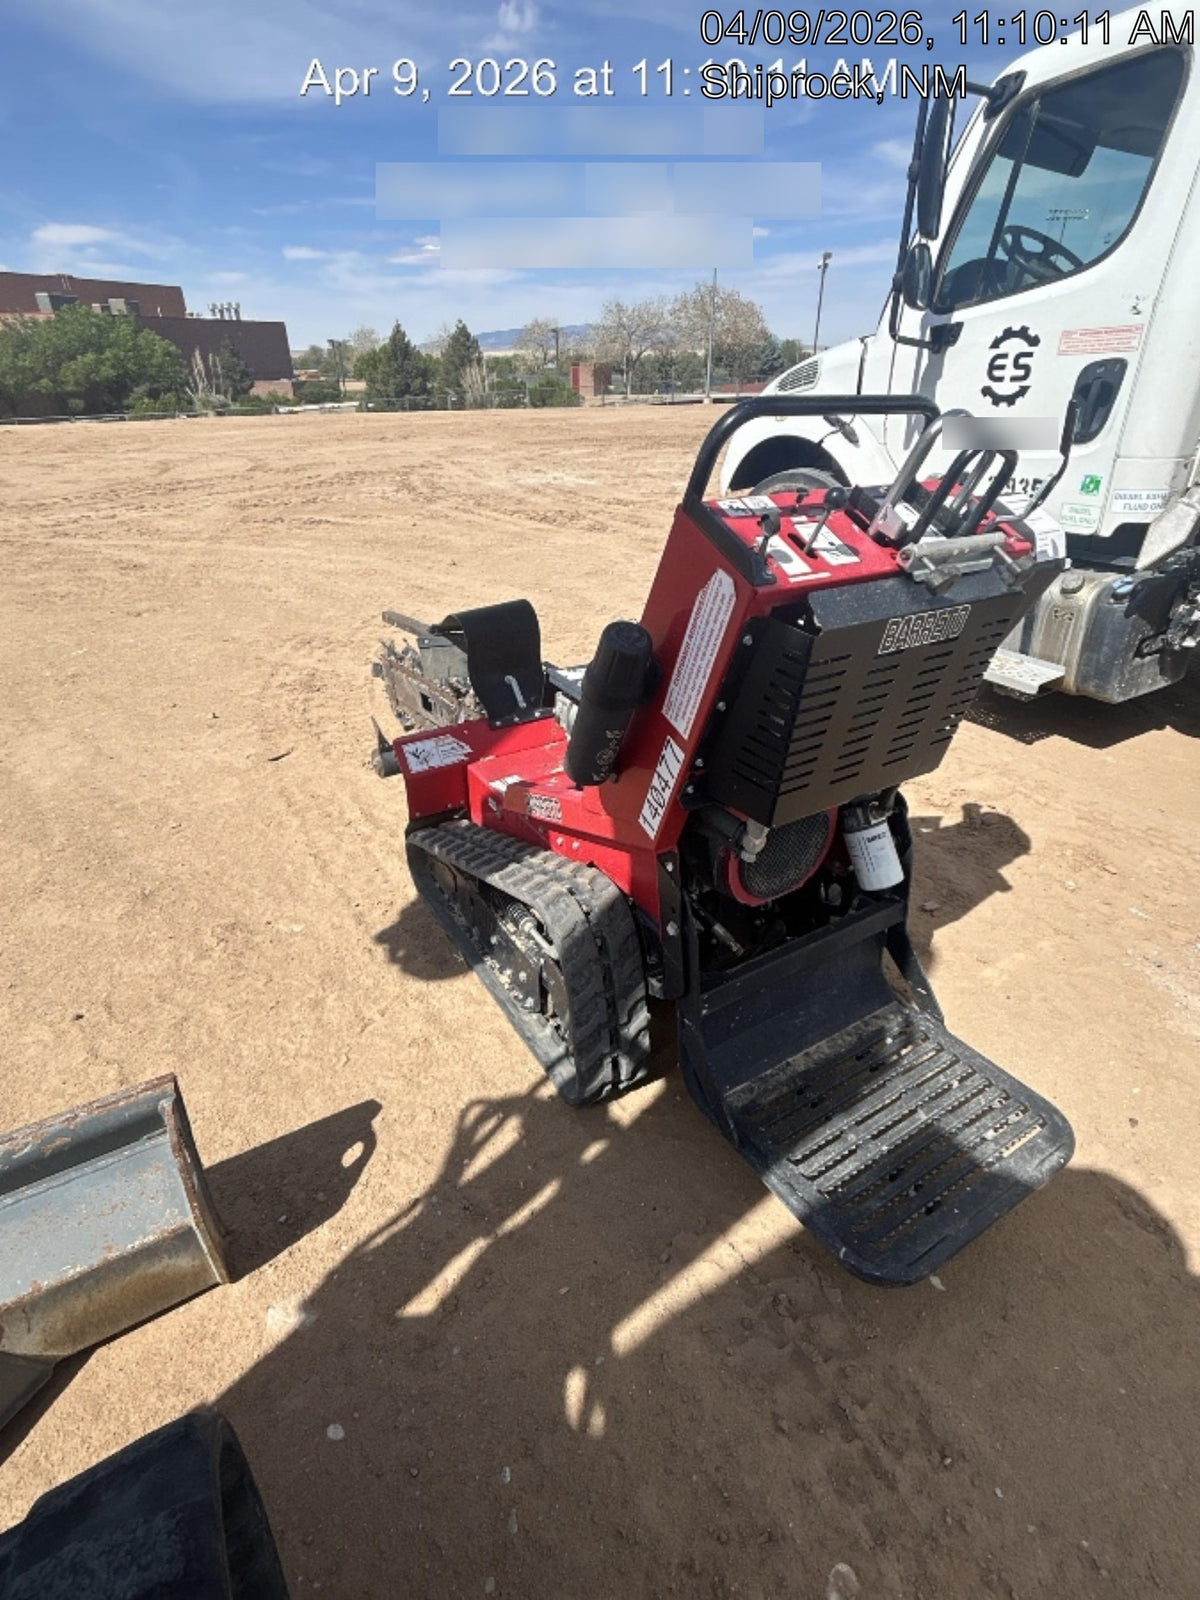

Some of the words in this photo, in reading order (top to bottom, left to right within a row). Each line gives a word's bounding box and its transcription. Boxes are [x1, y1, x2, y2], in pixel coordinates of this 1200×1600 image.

[987, 352, 1034, 383] ES
[878, 604, 971, 655] BARRETO
[641, 738, 682, 832] 140477
